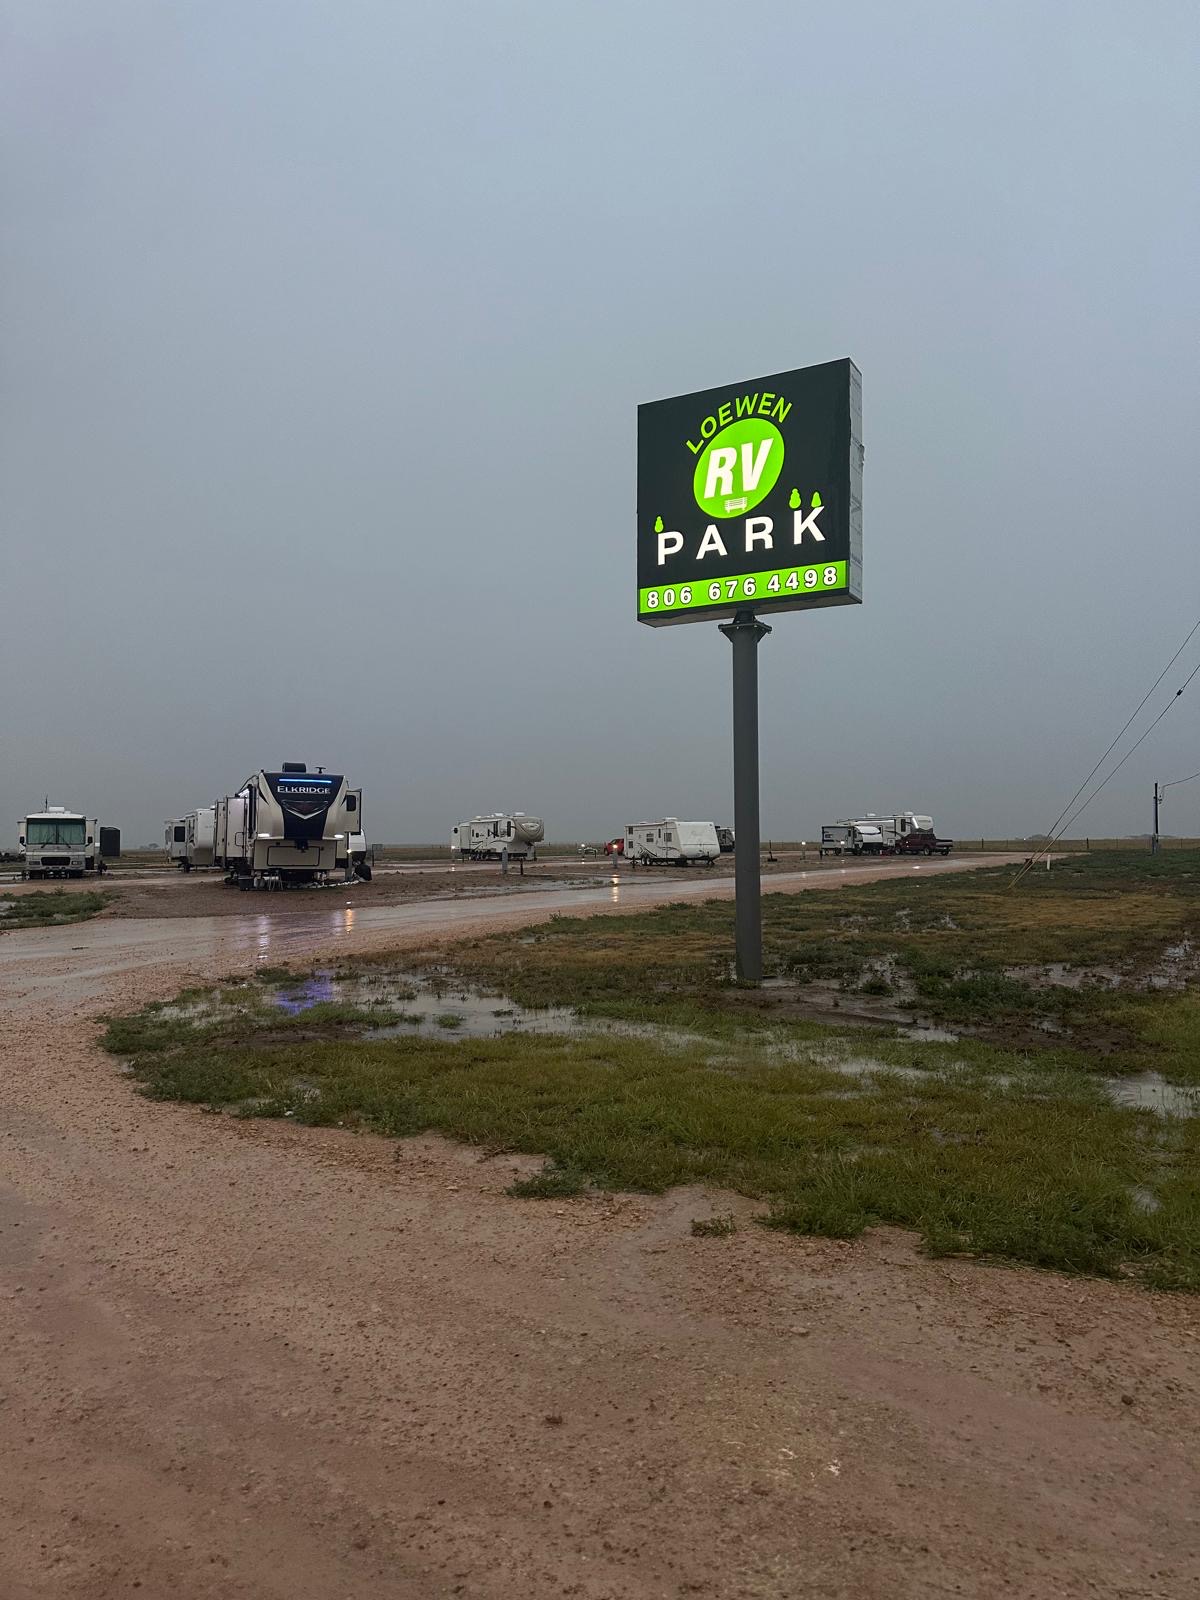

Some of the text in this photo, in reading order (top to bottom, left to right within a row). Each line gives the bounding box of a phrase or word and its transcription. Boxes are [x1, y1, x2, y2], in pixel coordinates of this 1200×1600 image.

[686, 392, 792, 454] LOEWEN
[703, 438, 774, 499] RV
[657, 506, 826, 566] PARK
[646, 566, 838, 609] 806 676 4498
[277, 785, 331, 794] ELKRIDGE
